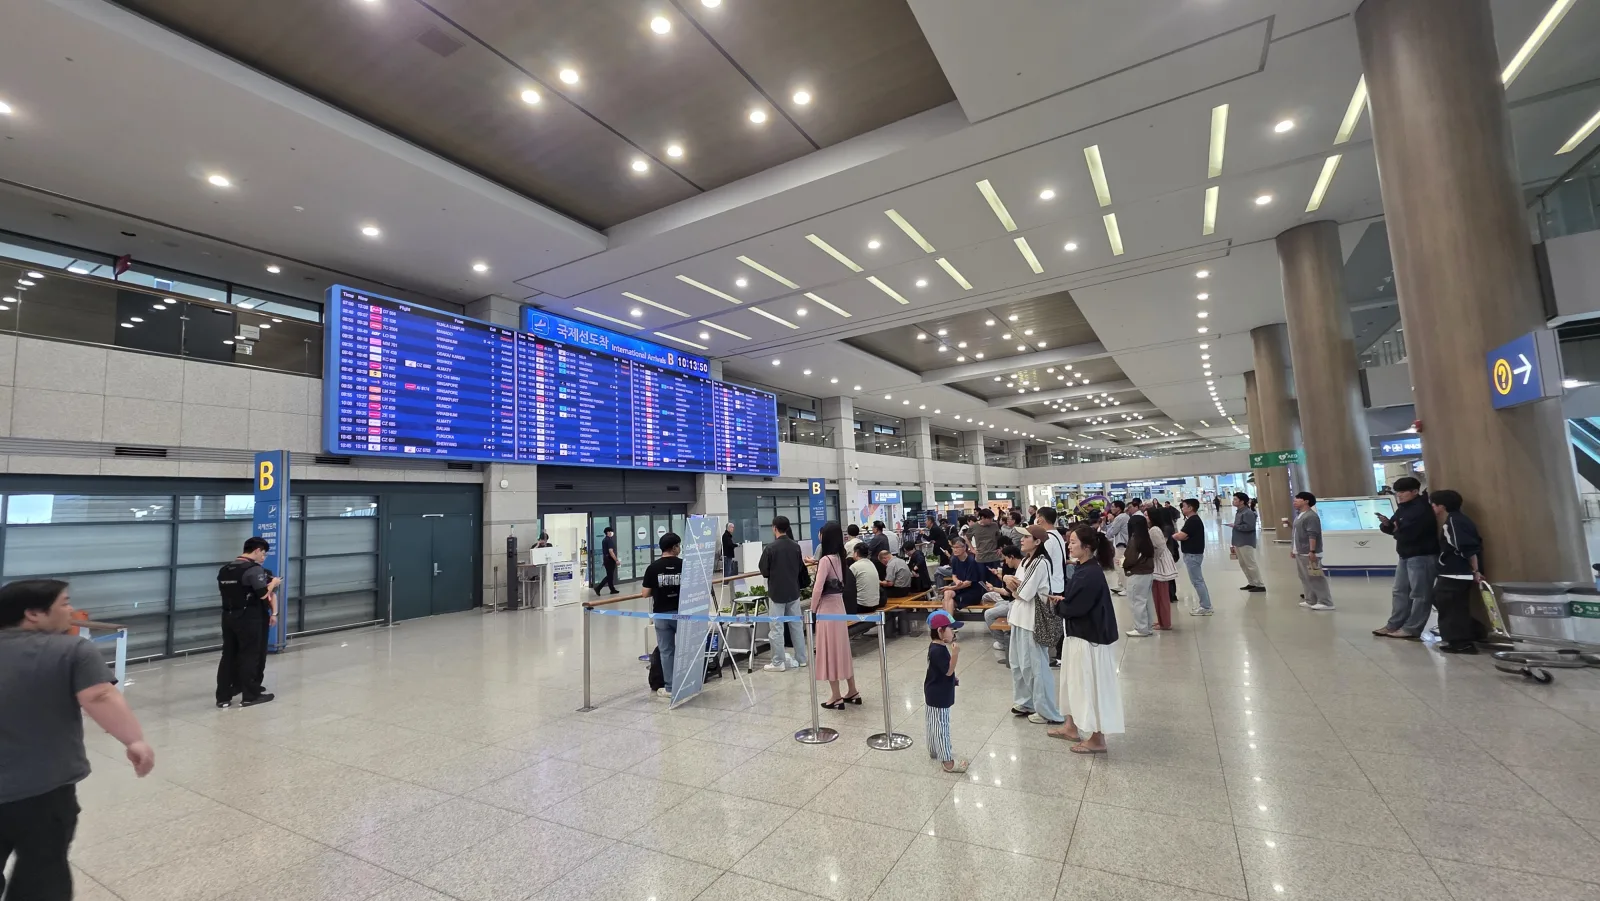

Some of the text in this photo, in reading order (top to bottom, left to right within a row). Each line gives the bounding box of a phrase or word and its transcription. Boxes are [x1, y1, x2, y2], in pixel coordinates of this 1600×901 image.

[557, 324, 609, 349] 국제선도착
[612, 344, 674, 365] International Arrivals B
[678, 357, 708, 372] 10:13:50
[260, 461, 274, 491] B
[812, 482, 821, 494] B
